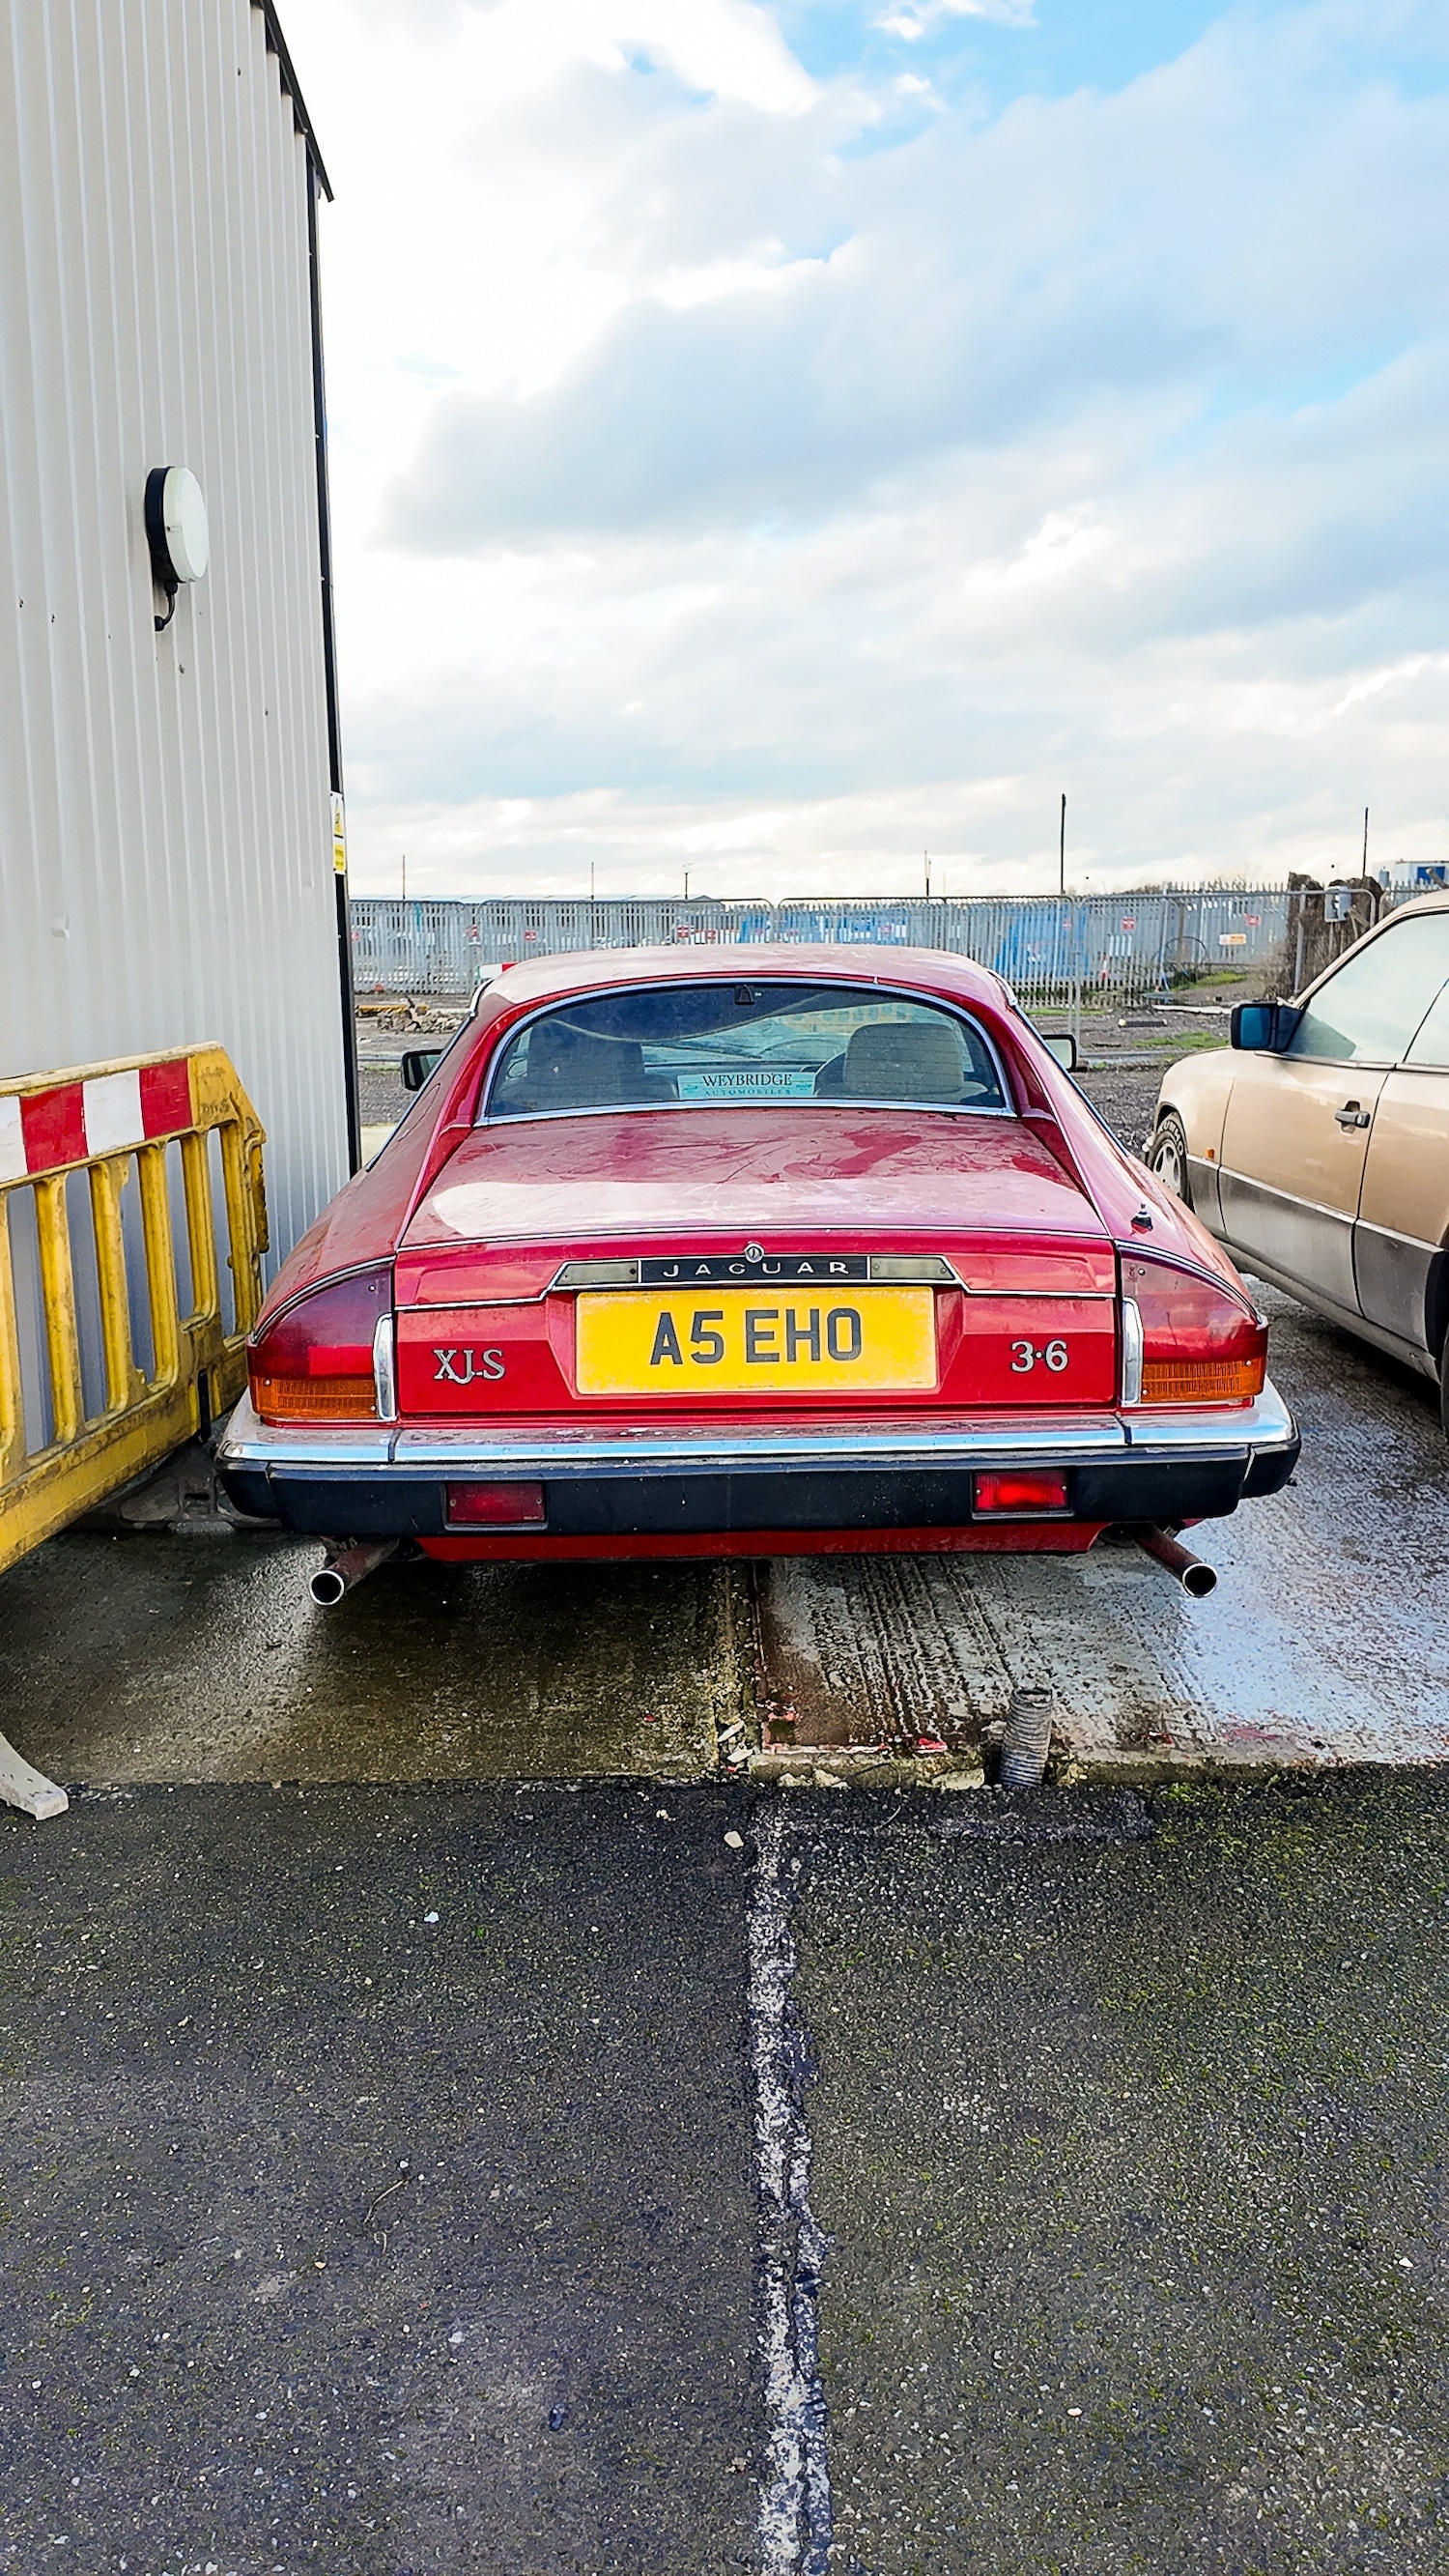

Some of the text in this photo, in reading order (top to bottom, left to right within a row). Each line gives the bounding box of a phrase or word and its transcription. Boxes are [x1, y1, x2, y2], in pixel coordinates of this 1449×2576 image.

[702, 1073, 793, 1087] WEYBRIDGE
[663, 1261, 850, 1277] JAGUAR
[649, 1307, 863, 1365] A5 EHO
